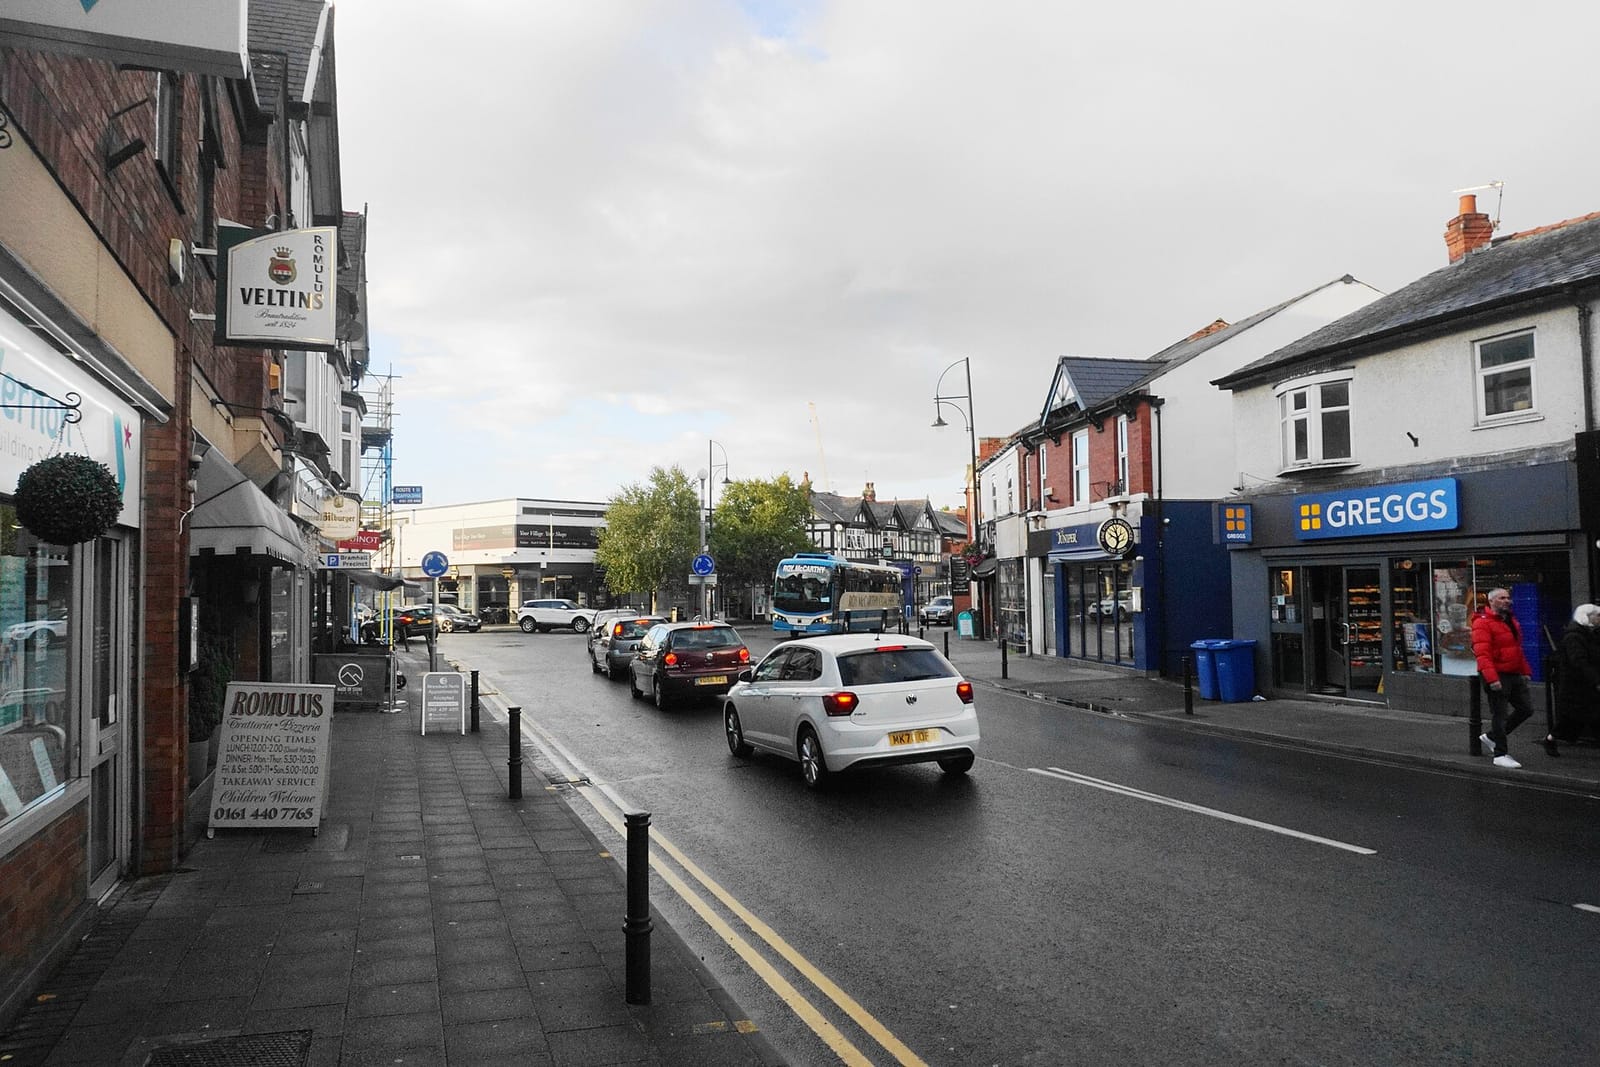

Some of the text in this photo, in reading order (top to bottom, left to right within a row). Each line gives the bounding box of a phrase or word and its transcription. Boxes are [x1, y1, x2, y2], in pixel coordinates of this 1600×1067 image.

[240, 287, 324, 310] VELTINS
[0, 350, 71, 447] ernon
[1326, 489, 1448, 528] GREGGS
[230, 691, 323, 718] ROMULUS
[227, 717, 321, 733] Trattoria Pizzeria
[231, 735, 316, 744] OPENING TIMES
[222, 777, 316, 786] TAKEAWAY SERVICE
[220, 789, 316, 805] Children Welcome
[214, 807, 314, 820] 0161 440 7765
